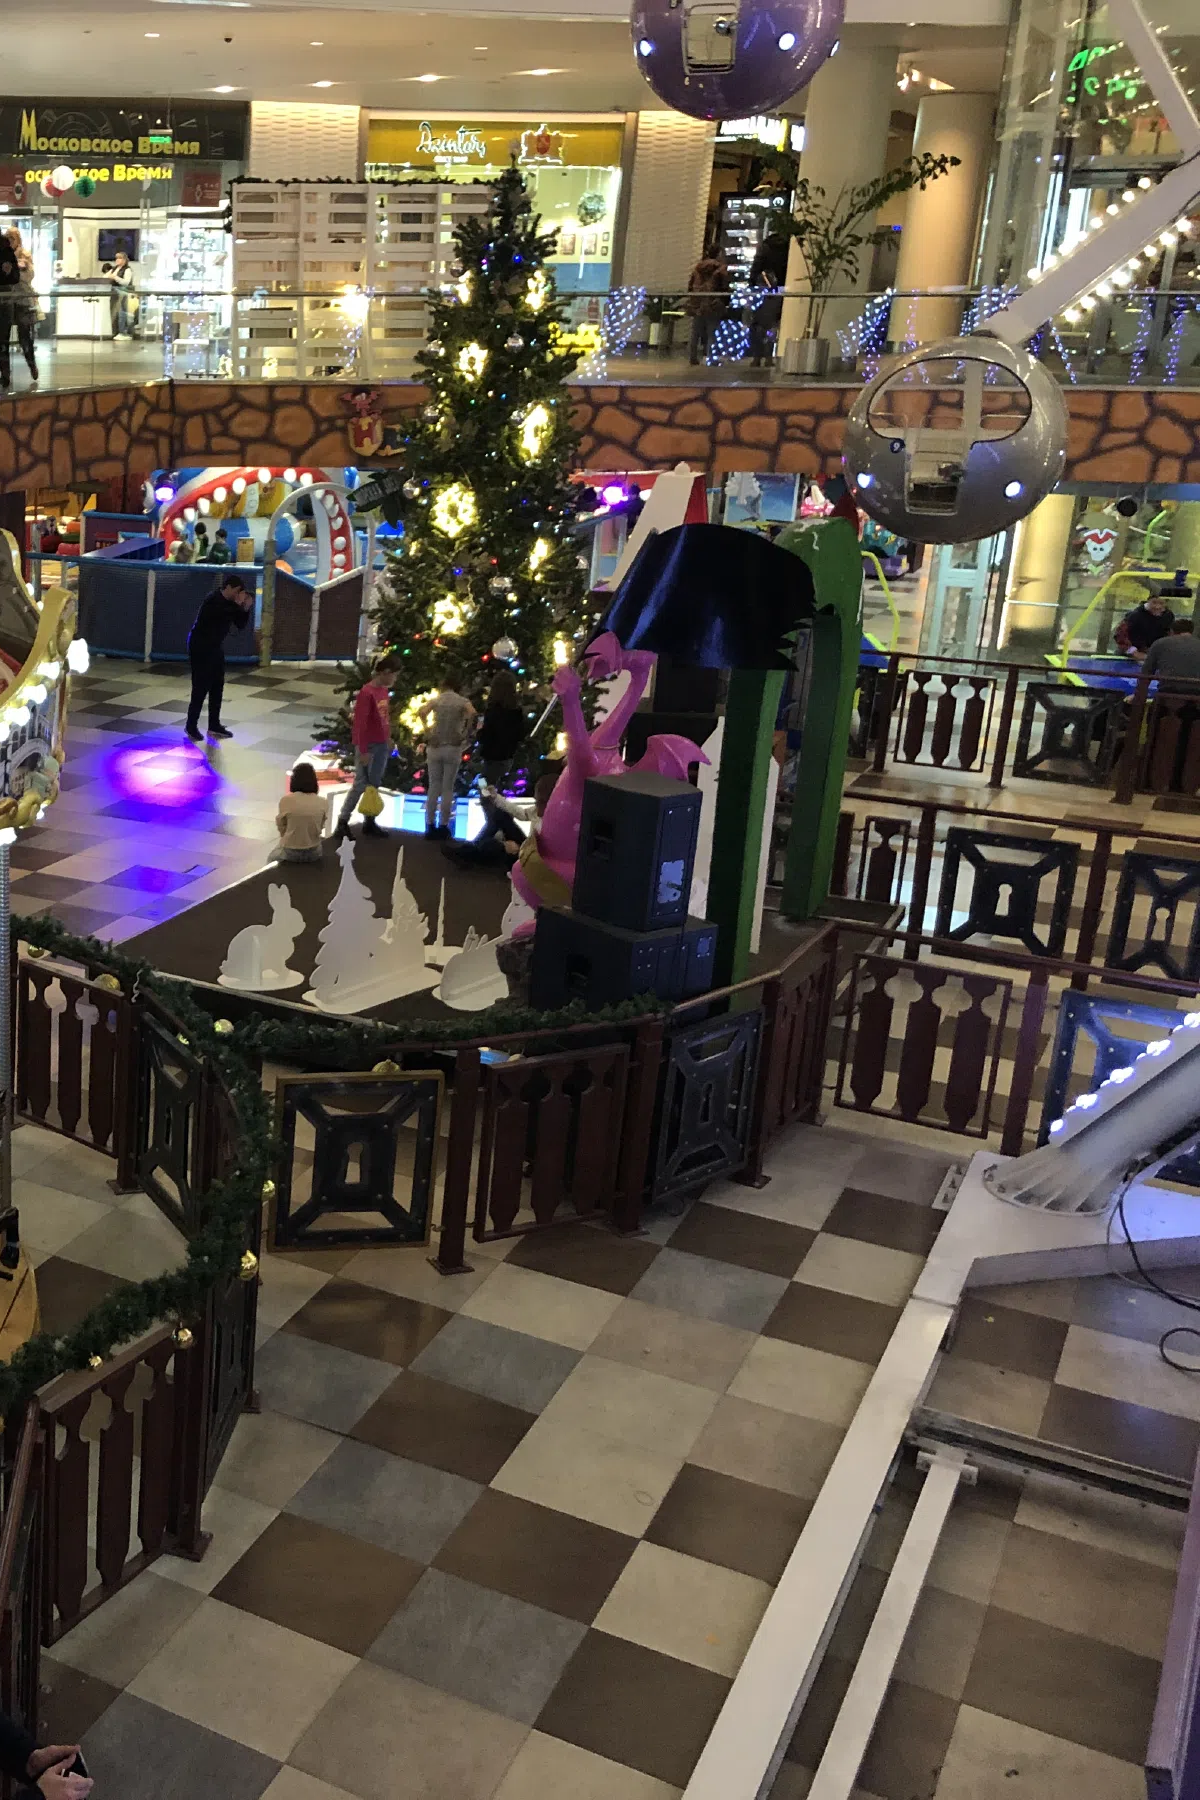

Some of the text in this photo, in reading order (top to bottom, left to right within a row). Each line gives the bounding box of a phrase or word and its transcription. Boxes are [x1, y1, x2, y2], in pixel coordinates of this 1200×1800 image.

[19, 108, 200, 155] Московское Время
[113, 164, 173, 181] Время
